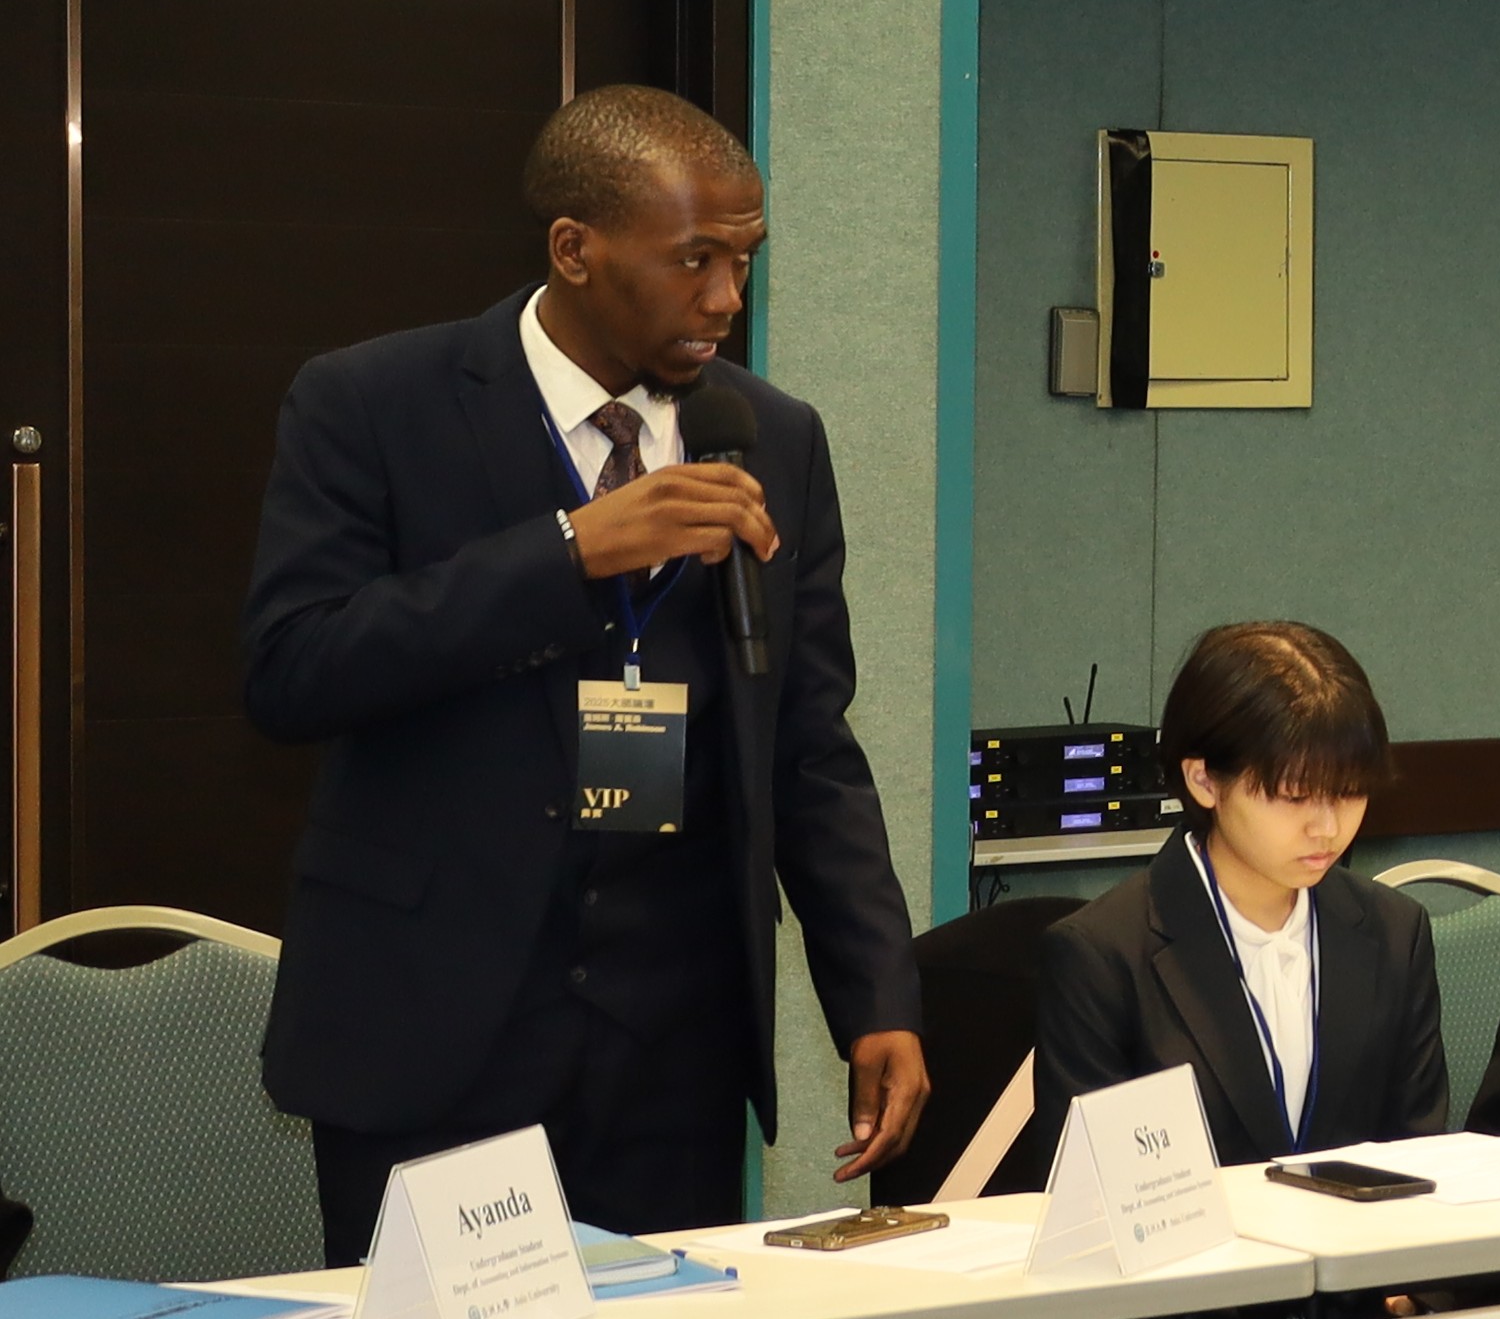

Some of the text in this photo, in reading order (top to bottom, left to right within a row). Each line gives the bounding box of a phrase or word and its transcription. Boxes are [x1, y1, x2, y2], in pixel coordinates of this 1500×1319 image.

[583, 788, 631, 809] VIP
[1133, 1124, 1171, 1161] Siya
[457, 1186, 533, 1240] Ayanda
